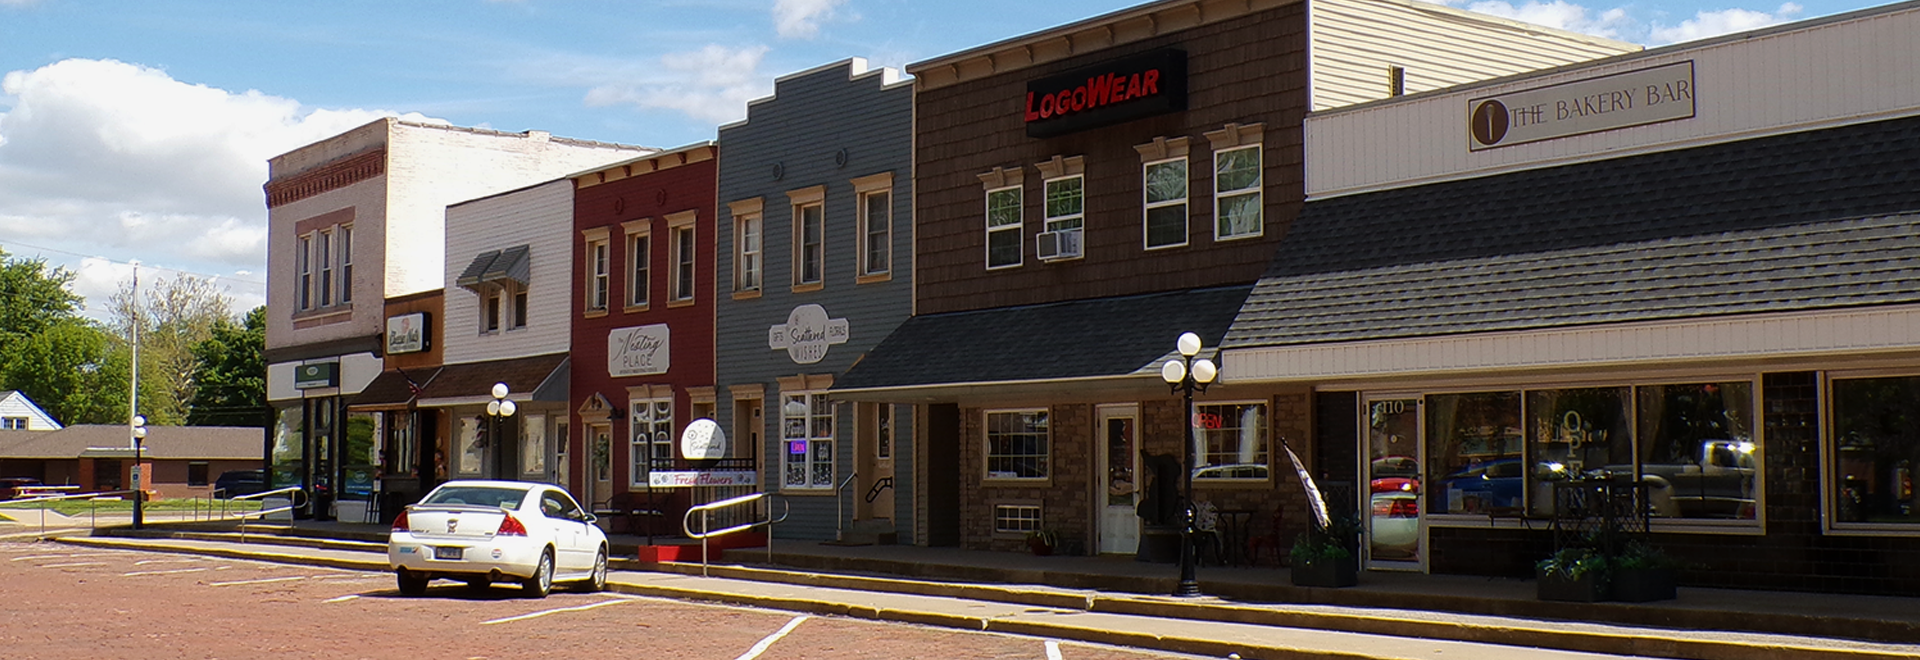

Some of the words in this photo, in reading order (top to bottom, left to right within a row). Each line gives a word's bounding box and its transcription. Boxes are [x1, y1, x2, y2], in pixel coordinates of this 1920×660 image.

[1510, 103, 1547, 127] THE
[1556, 88, 1637, 120] BAKERY
[1646, 79, 1691, 106] BAR
[790, 325, 826, 345] Scattered
[612, 327, 664, 362] Nesting
[794, 344, 822, 361] WISHES
[622, 353, 653, 368] PLACE
[1192, 412, 1222, 429] OPEN
[673, 473, 698, 486] Fresh
[700, 472, 733, 486] Flowers
